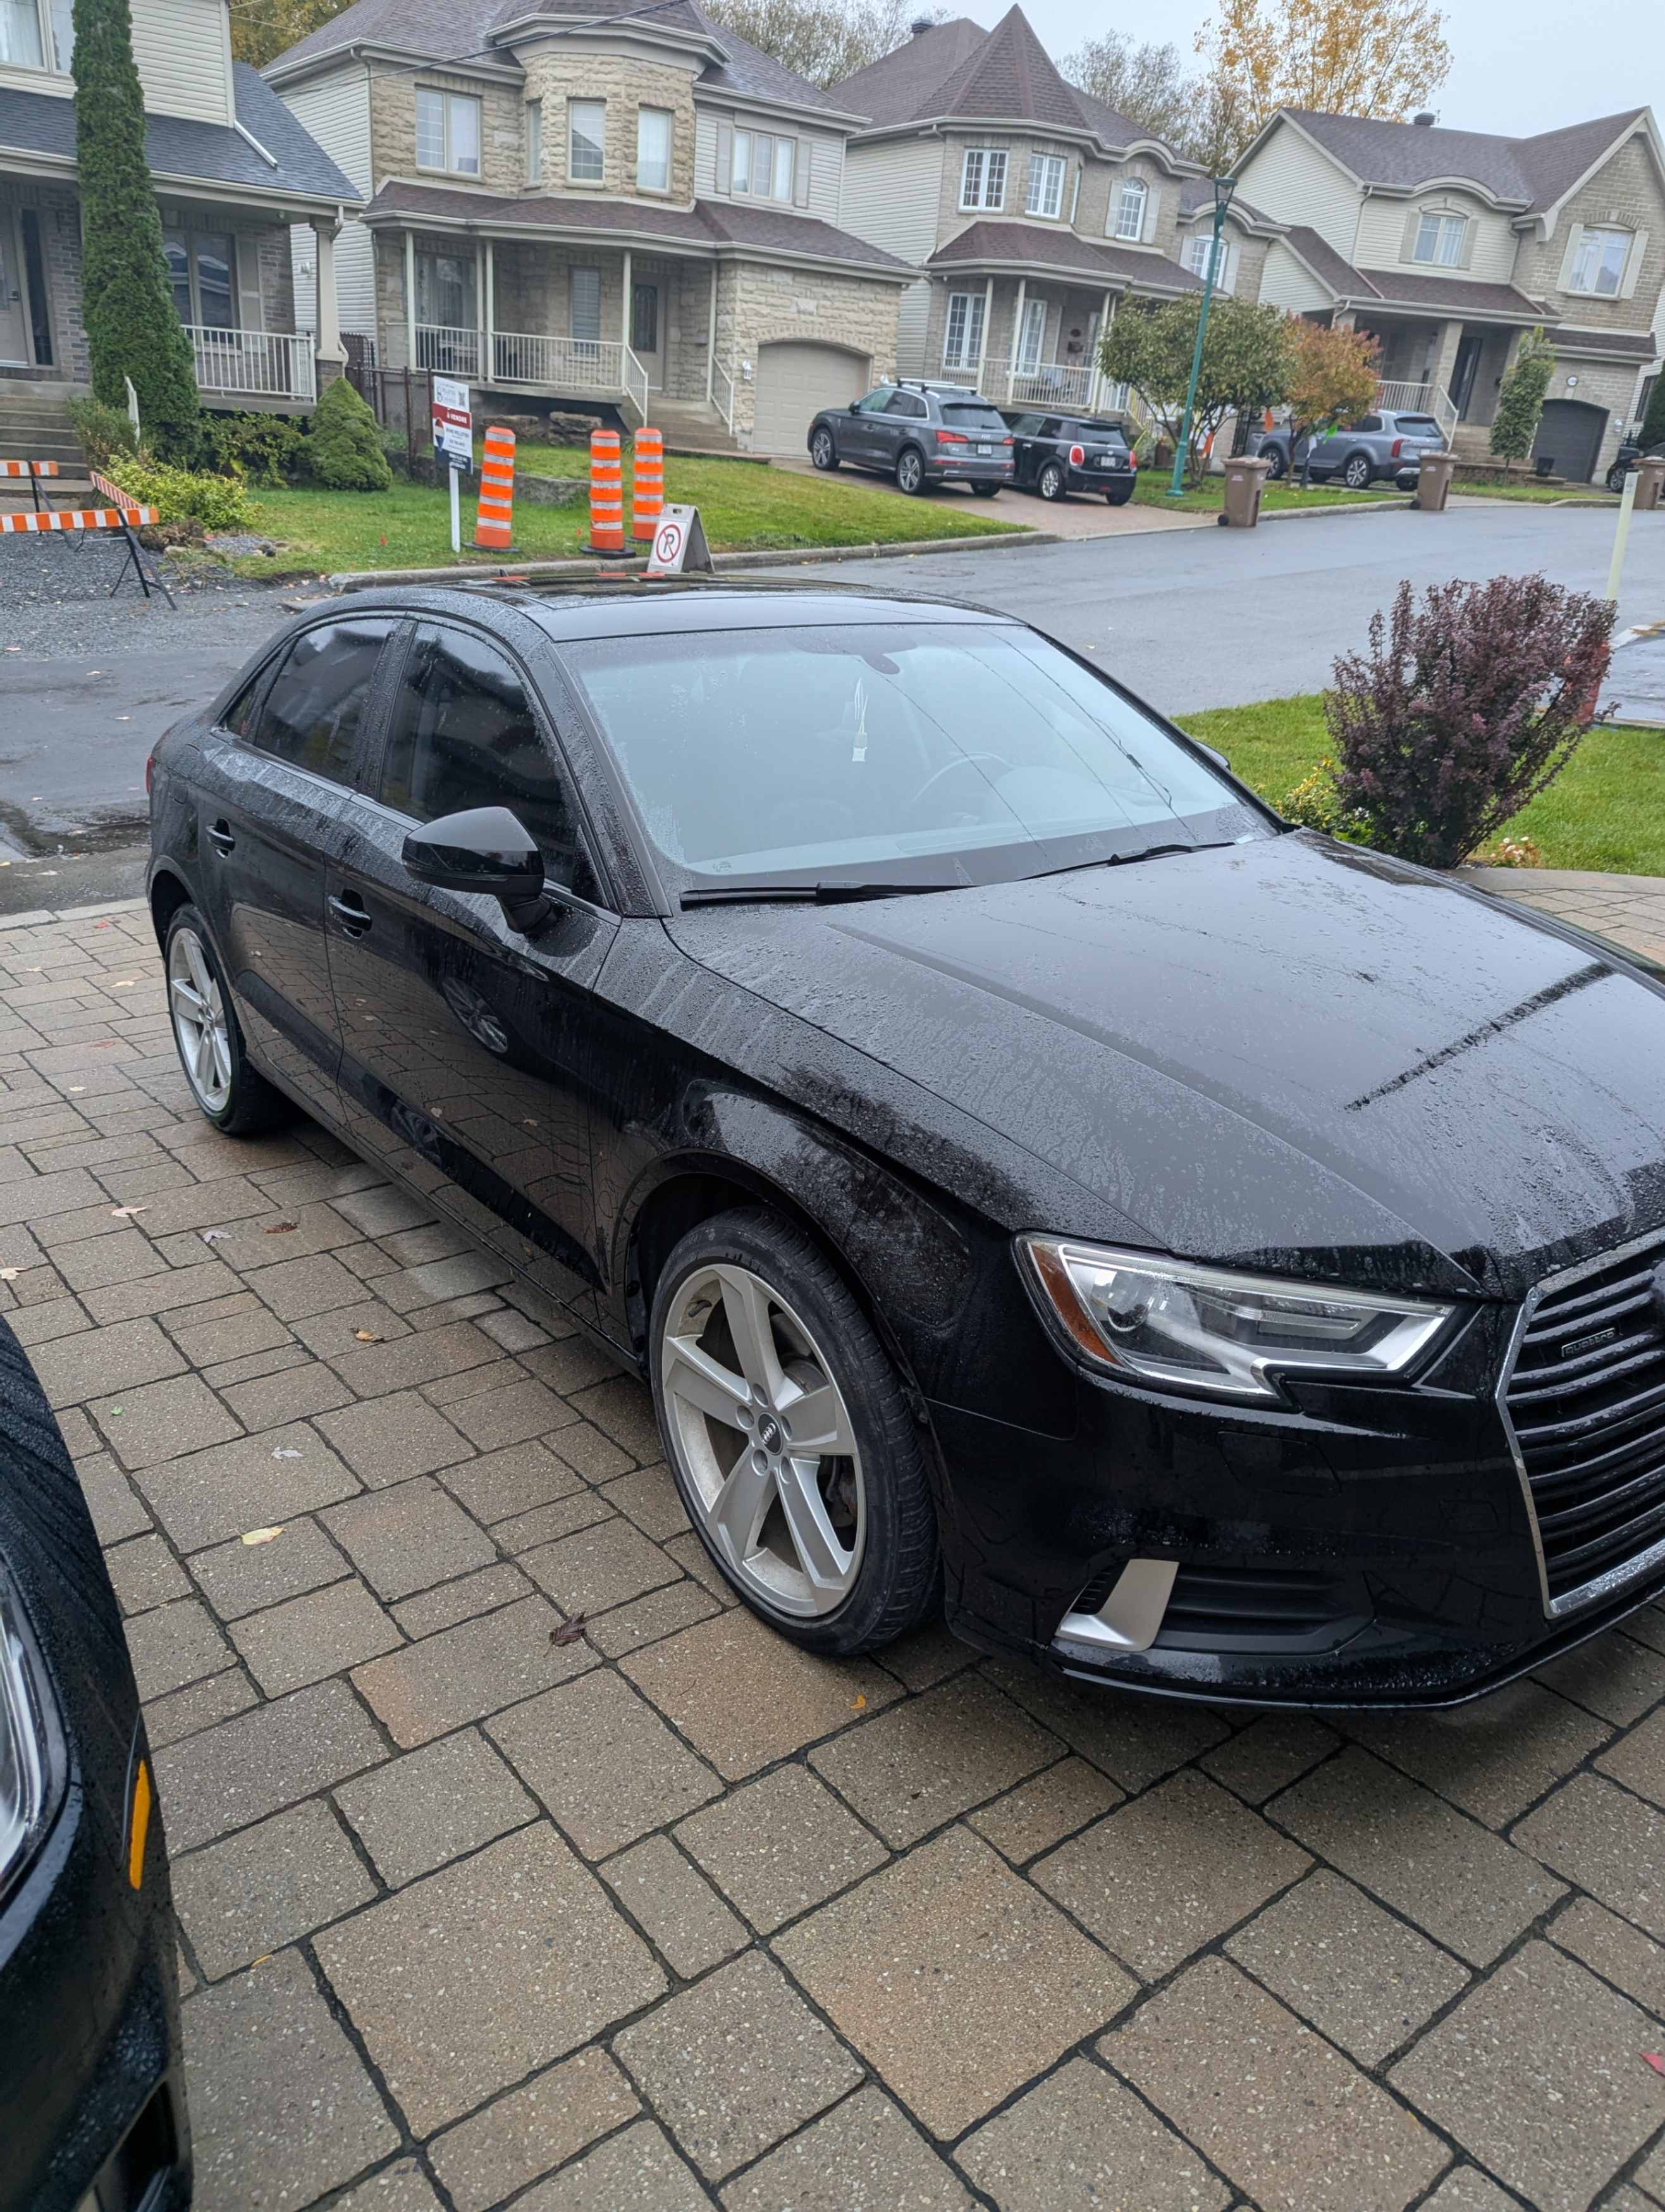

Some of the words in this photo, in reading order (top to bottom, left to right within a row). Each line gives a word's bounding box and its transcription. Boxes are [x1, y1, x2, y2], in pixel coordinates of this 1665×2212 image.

[450, 413, 467, 424] VENDRE
[663, 533, 675, 553] P
[1564, 1331, 1614, 1354] quattro
